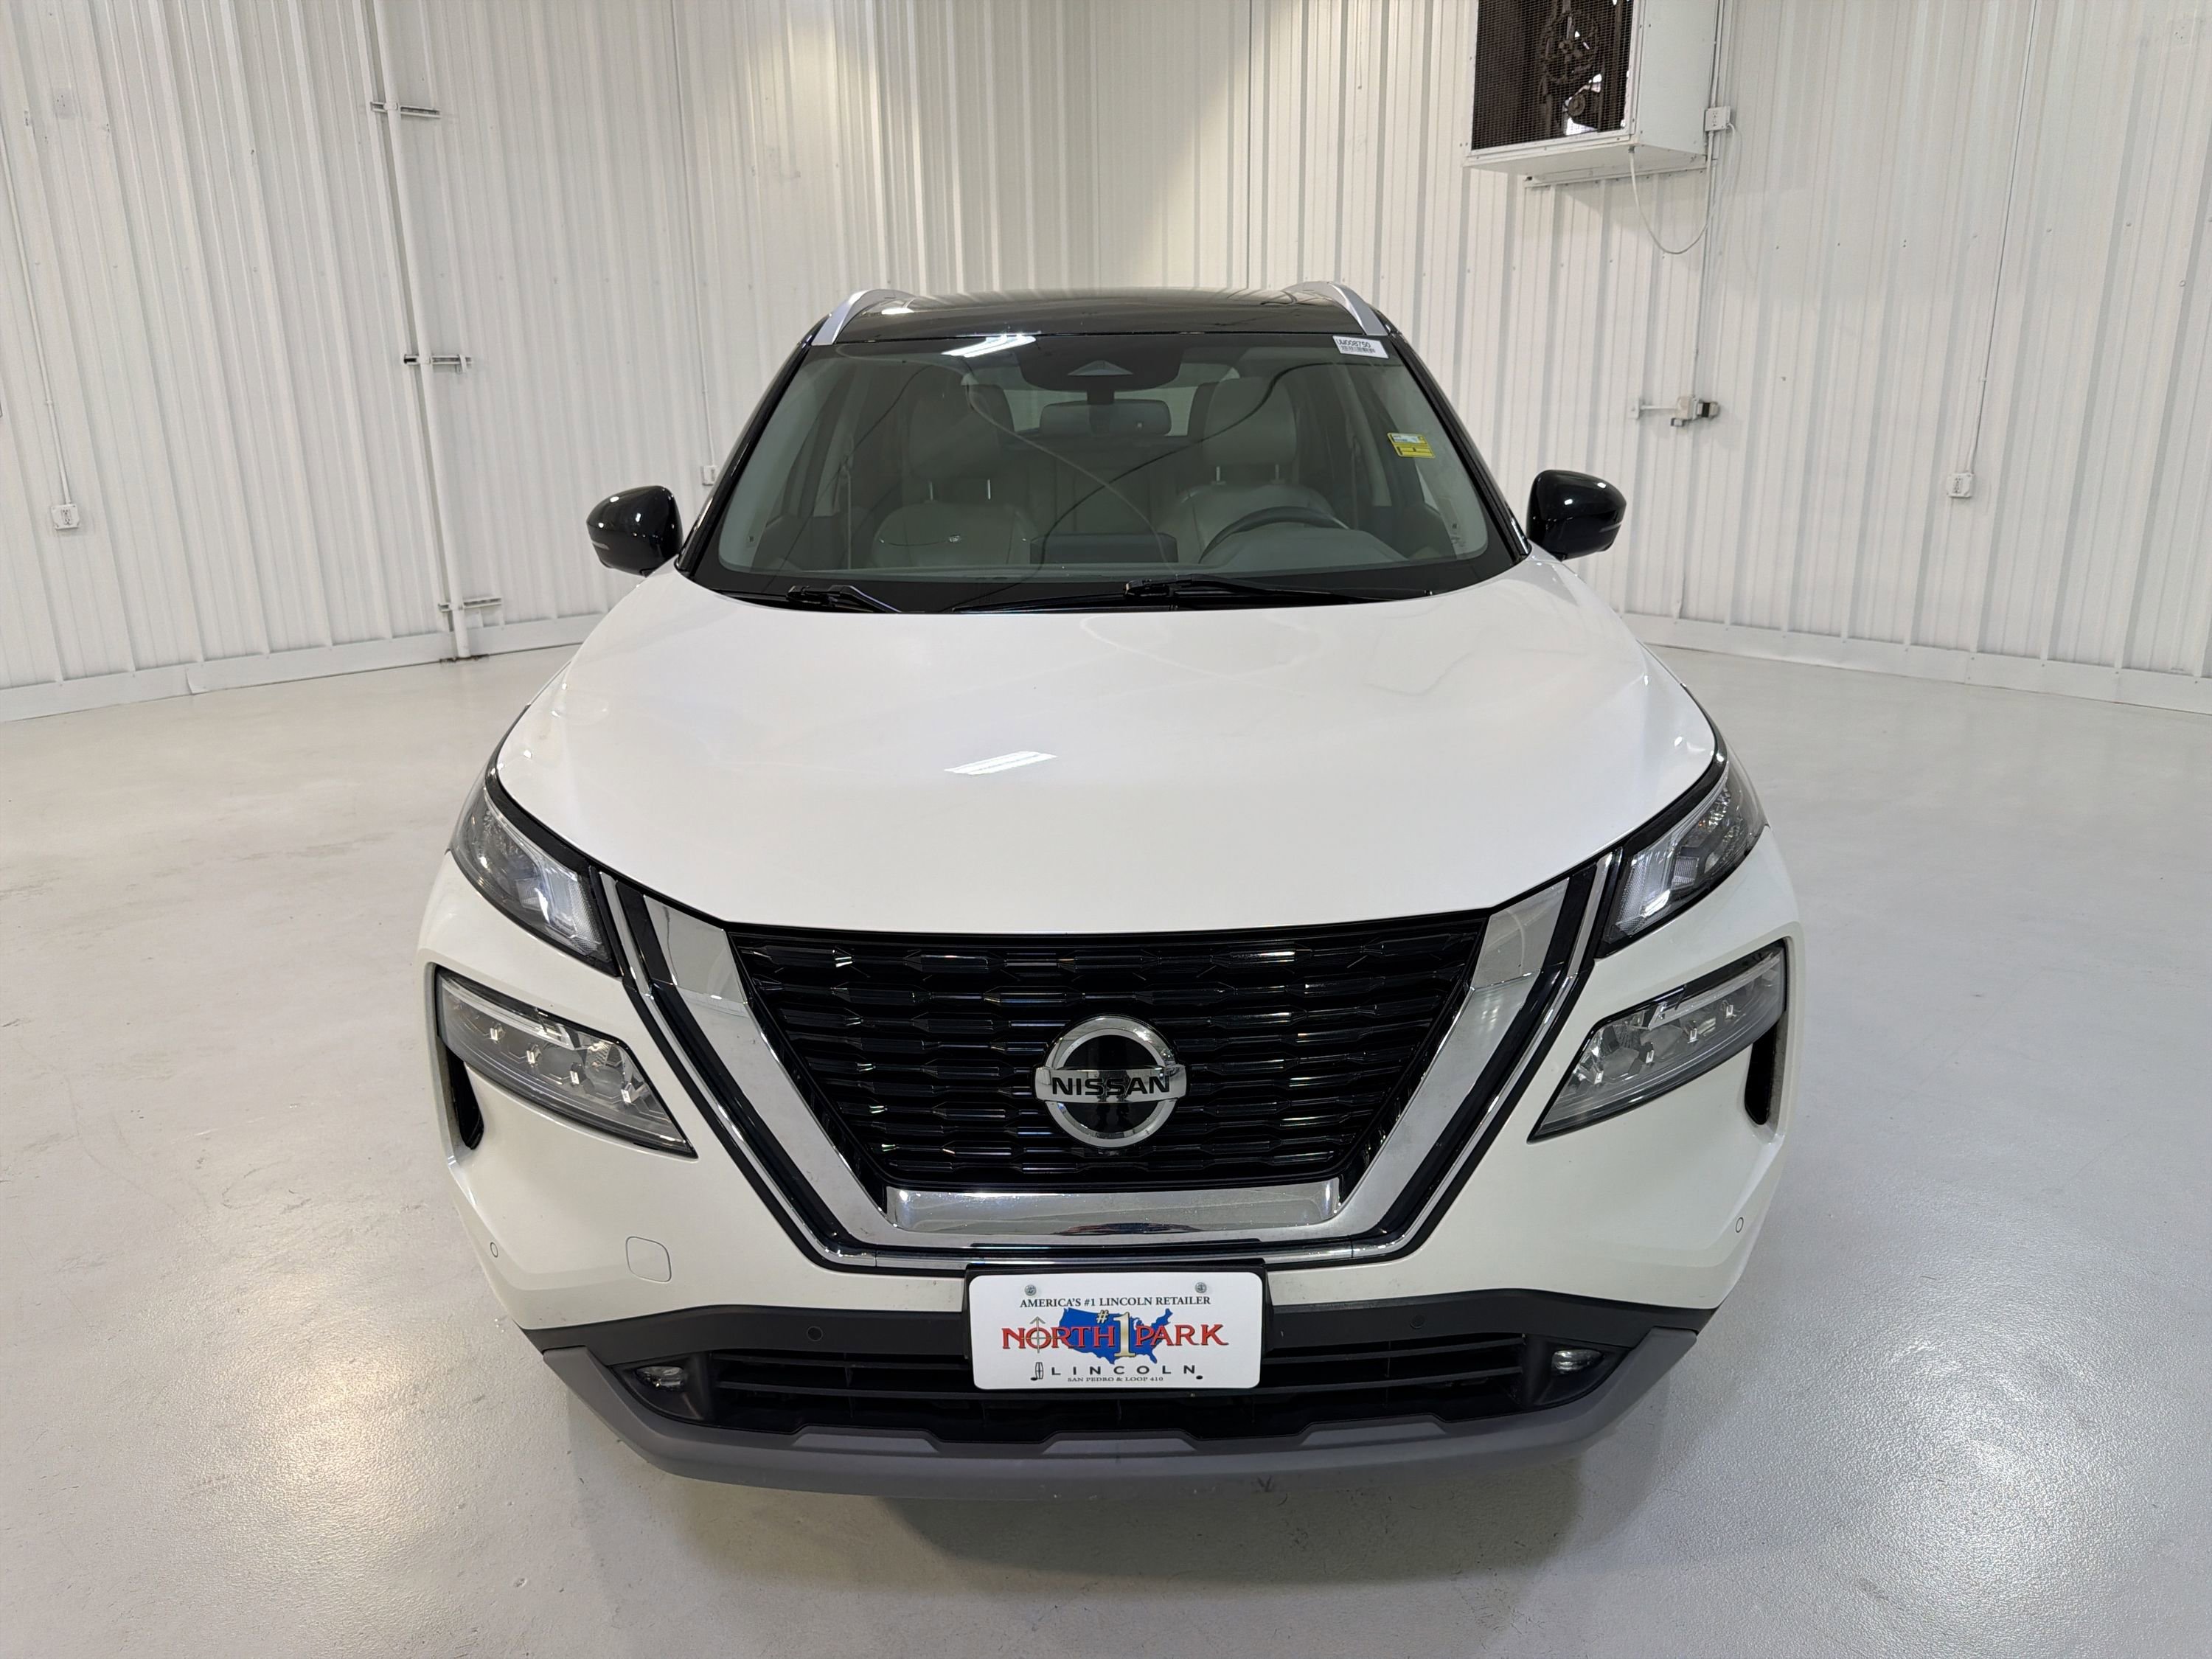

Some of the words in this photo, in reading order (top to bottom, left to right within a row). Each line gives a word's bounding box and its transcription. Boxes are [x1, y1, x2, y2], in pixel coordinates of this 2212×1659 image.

[1052, 1077, 1170, 1096] NISSAN
[1020, 1298, 1081, 1307] AMERICA'S
[1084, 1298, 1096, 1307] #1
[1099, 1297, 1152, 1307] LINCOLN
[1155, 1296, 1211, 1305] RETAILER
[1001, 1326, 1115, 1349] NORTH
[1135, 1324, 1229, 1346] PARK
[1051, 1365, 1195, 1375] LINCOLN
